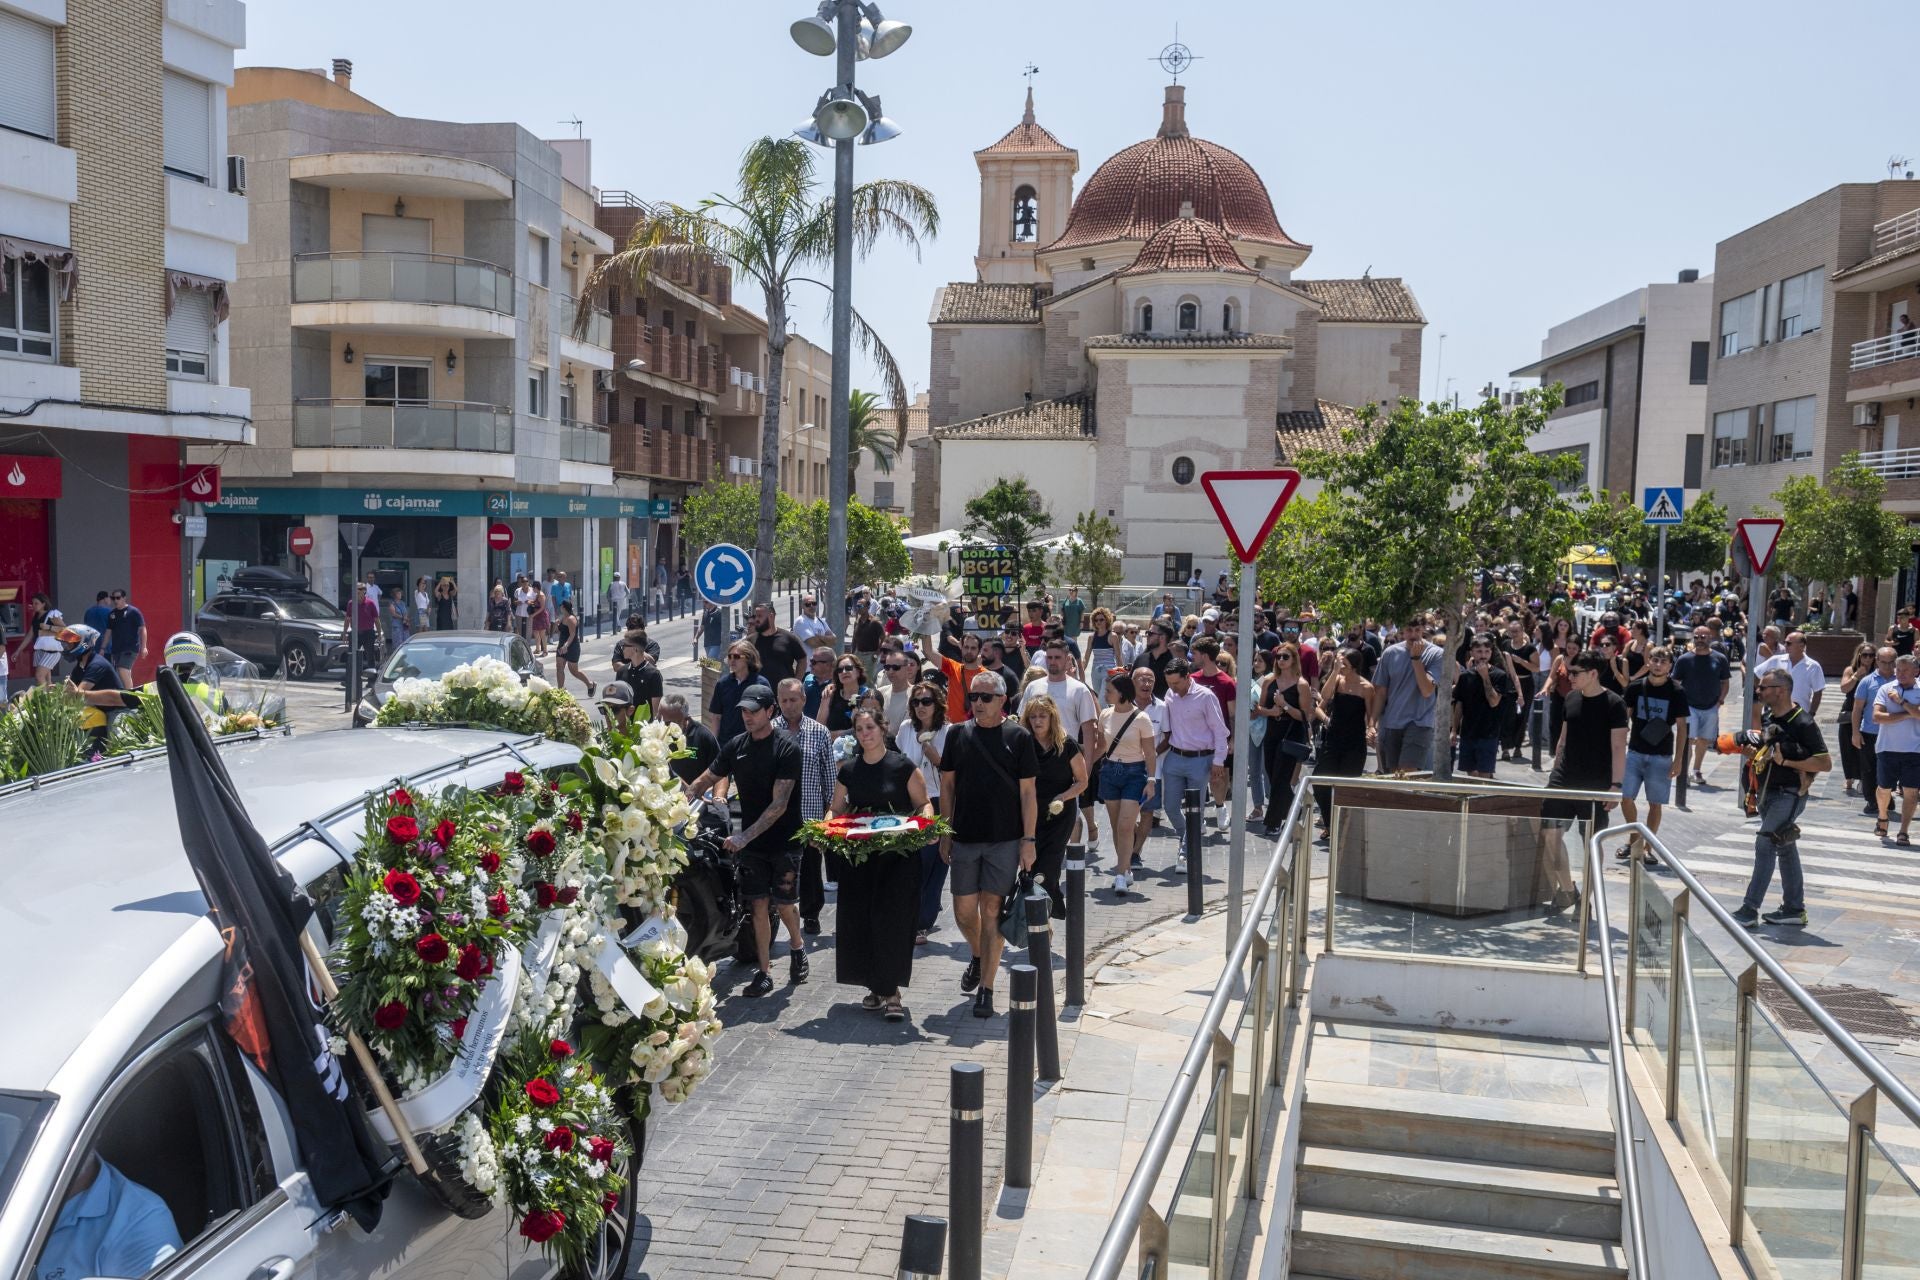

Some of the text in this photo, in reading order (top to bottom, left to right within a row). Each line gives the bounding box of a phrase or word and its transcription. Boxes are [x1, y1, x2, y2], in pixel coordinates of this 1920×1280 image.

[220, 493, 259, 508] cajamar
[385, 495, 442, 511] cajamar
[962, 550, 1014, 558] BORJA G.
[965, 559, 1012, 576] BG12
[969, 576, 1004, 594] L50
[976, 595, 1000, 612] P1
[977, 614, 1001, 629] OK
[469, 1010, 488, 1050] hermanos
